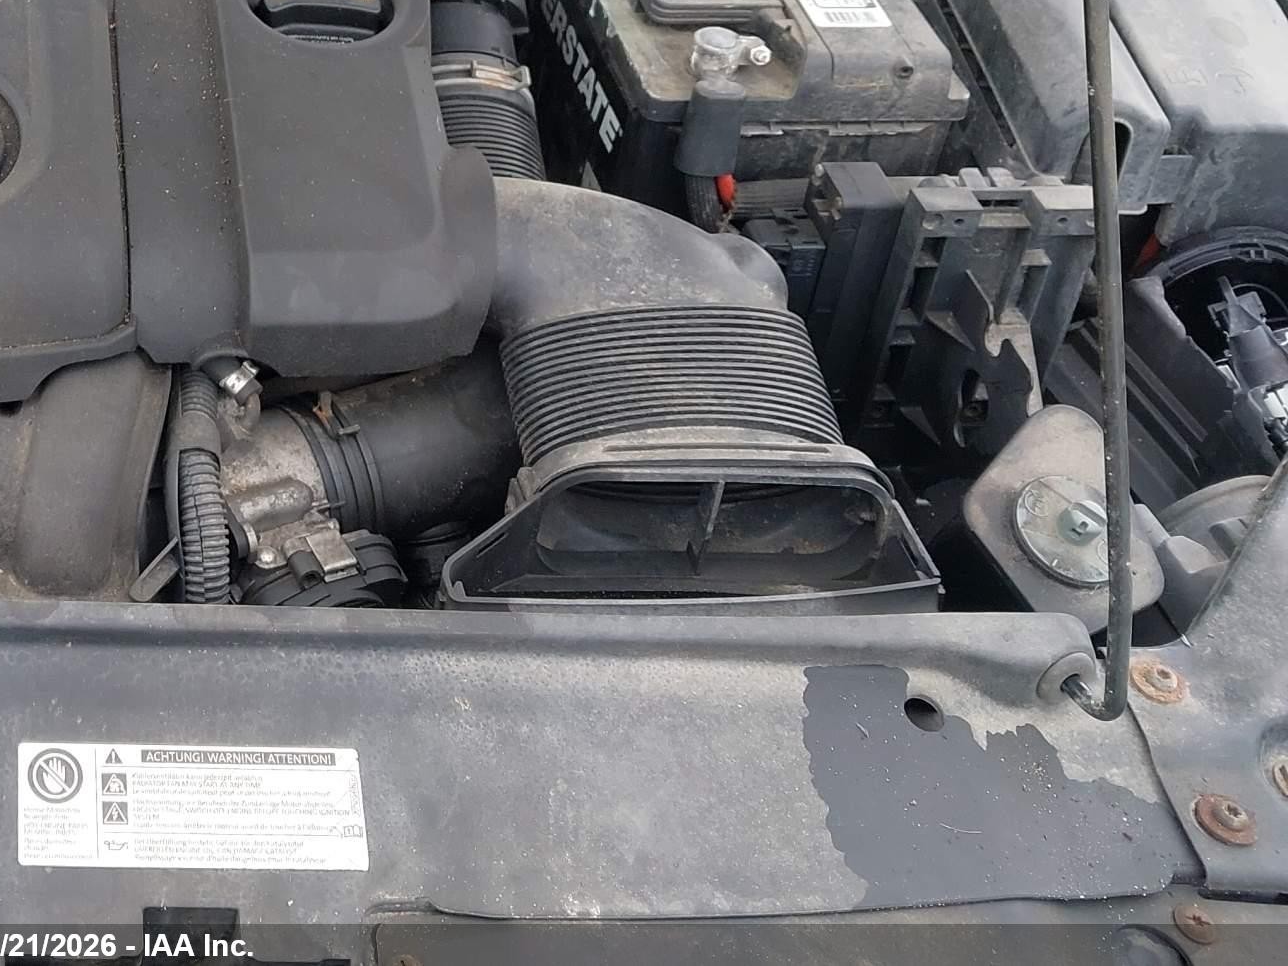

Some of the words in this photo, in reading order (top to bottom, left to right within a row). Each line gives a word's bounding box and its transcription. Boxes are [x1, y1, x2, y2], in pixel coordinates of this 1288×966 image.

[146, 750, 204, 763] ACHTUNG!
[207, 752, 265, 765] WARNING!
[267, 753, 332, 766] ATTENTION!
